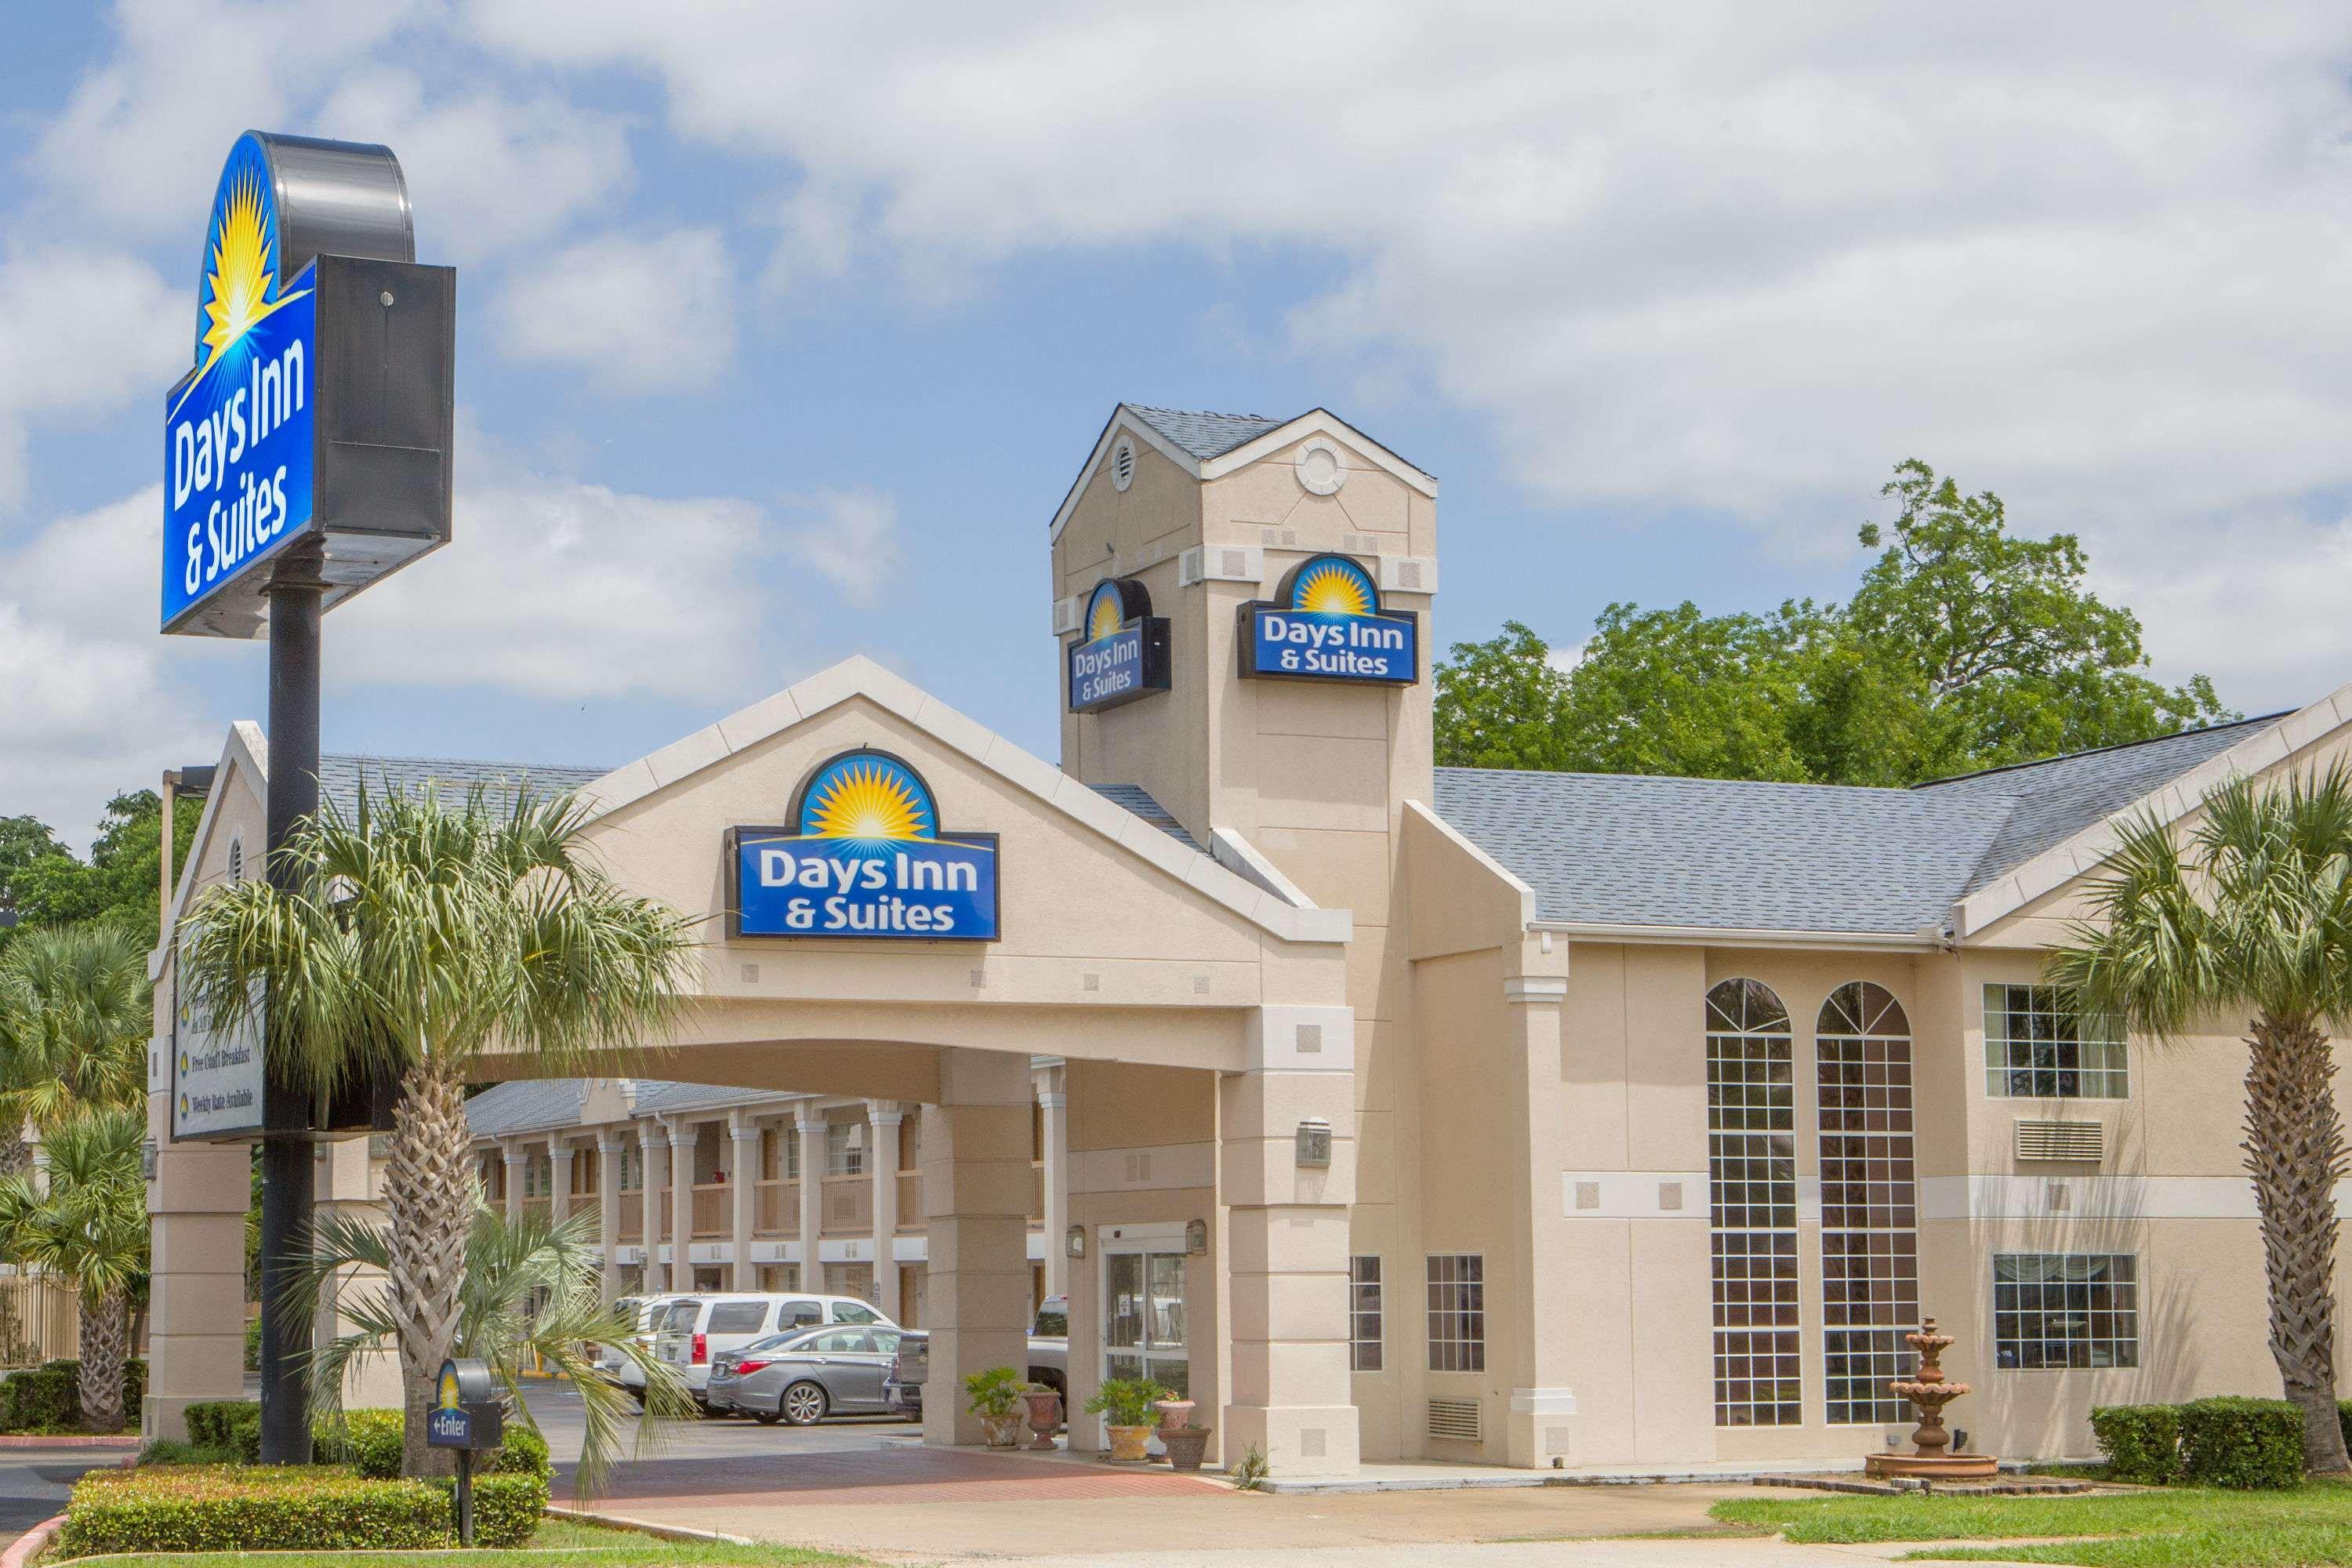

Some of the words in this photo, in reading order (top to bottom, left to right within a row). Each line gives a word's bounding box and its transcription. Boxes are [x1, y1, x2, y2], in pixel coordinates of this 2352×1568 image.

[174, 387, 246, 513] Days
[251, 338, 304, 448] Inn
[185, 521, 203, 596] &
[205, 465, 287, 583] Suites
[1264, 615, 1345, 648] Days
[1350, 622, 1403, 650] Inn
[1075, 648, 1112, 679] Days
[1113, 639, 1138, 666] Inn
[1280, 649, 1300, 670] &
[1305, 649, 1388, 675] Suites
[1083, 682, 1091, 701] &
[1093, 670, 1131, 698] Suites
[760, 849, 887, 894] Days
[896, 852, 978, 891] Inn
[786, 898, 815, 929] &
[824, 895, 955, 931] Suites
[192, 1056, 204, 1073] Free
[221, 1046, 250, 1067] Breakfast
[192, 1095, 211, 1114] Weekly
[212, 1094, 226, 1110] Rate
[226, 1088, 253, 1109] Available
[441, 1416, 466, 1436] Enter
